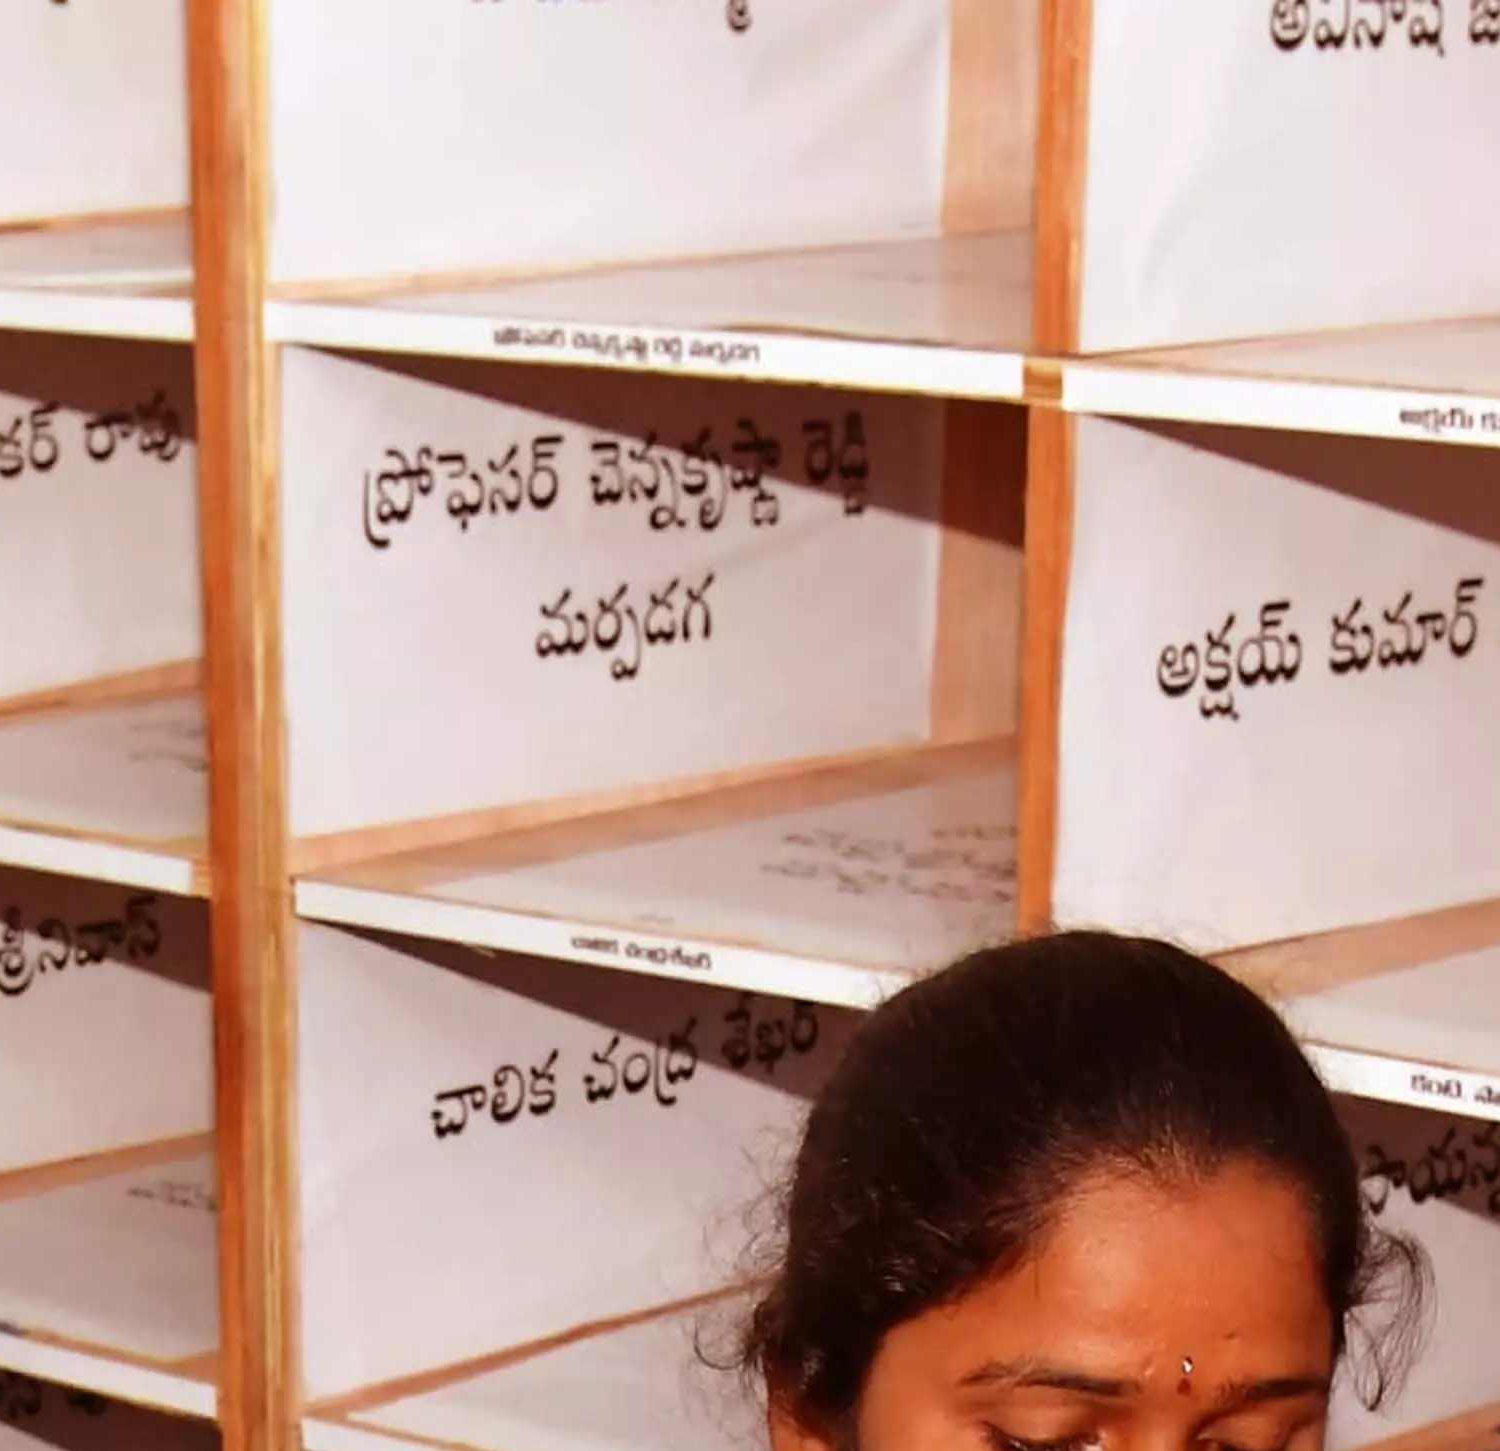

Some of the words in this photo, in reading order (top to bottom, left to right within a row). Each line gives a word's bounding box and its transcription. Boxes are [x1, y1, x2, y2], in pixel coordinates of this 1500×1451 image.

[1156, 600, 1306, 721] అక్షయ్
[1327, 576, 1488, 680] కుమార్
[429, 1048, 560, 1139] చాలిక
